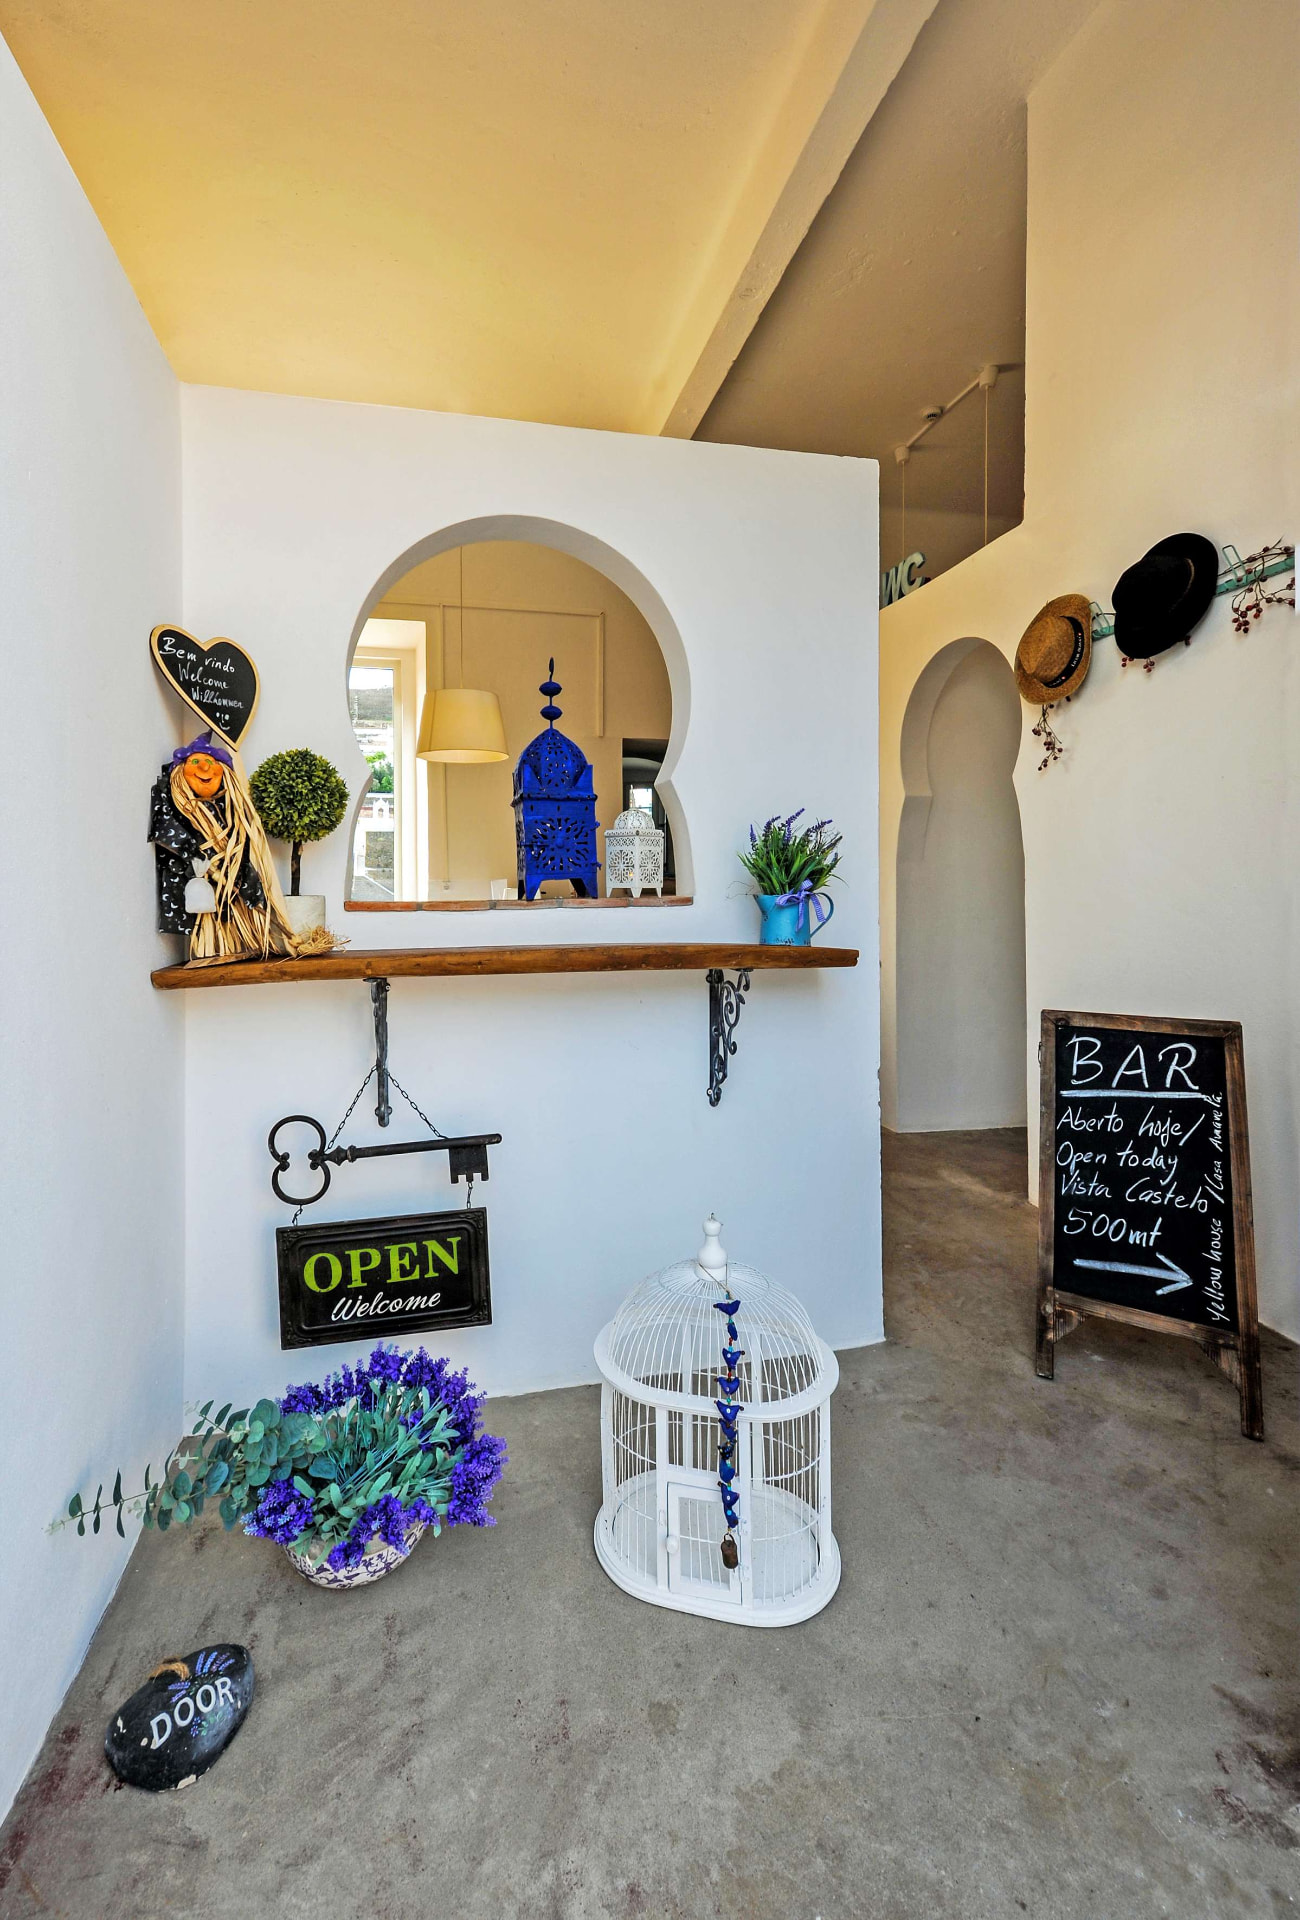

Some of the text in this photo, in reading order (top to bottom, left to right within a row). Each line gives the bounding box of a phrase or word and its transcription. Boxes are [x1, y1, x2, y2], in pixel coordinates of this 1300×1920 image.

[881, 551, 925, 608] WC
[159, 637, 197, 662] Bem
[179, 661, 230, 689] Welcome
[191, 686, 244, 709] Willkommen
[1066, 1033, 1199, 1090] BAR
[1057, 1102, 1124, 1132] Aberto
[1057, 1140, 1179, 1185] Open today
[1061, 1169, 1208, 1213] Vista Castelo
[1202, 1218, 1224, 1262] house
[303, 1237, 462, 1293] OPEN
[331, 1291, 441, 1321] Welcome
[150, 1676, 234, 1750] DOOR
